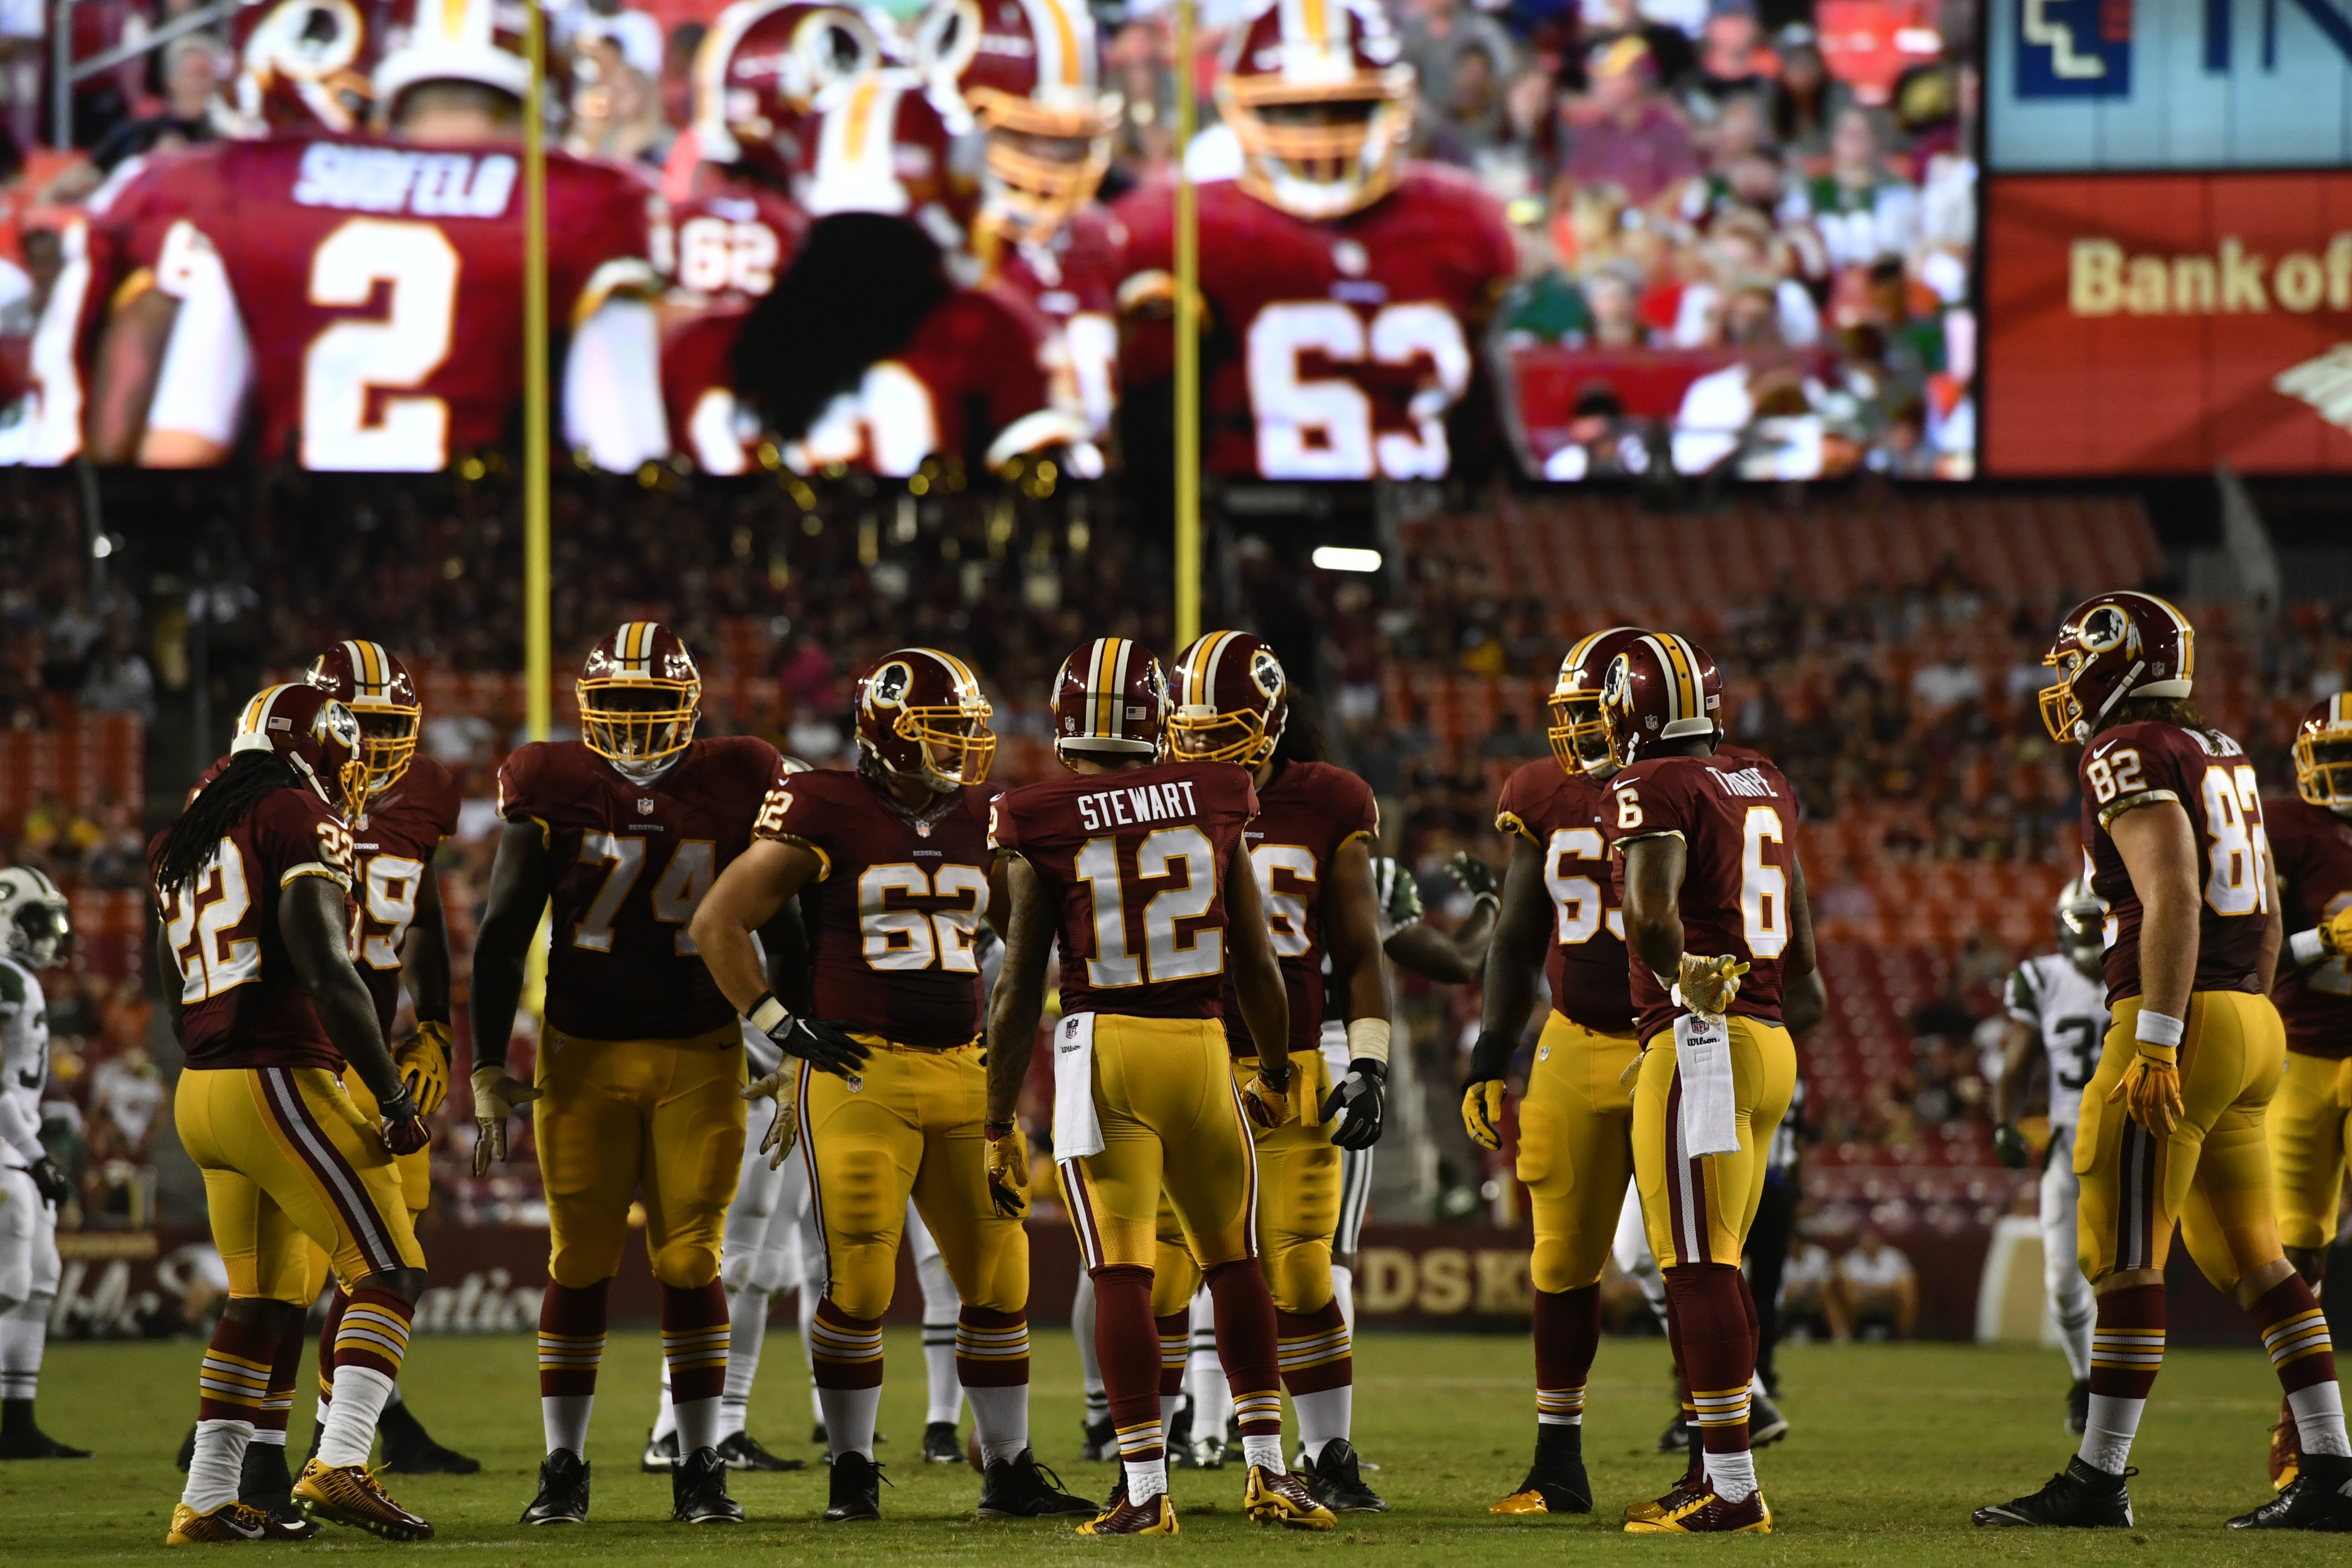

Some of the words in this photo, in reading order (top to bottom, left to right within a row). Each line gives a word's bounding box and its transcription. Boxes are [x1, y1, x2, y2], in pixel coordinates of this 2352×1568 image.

[680, 216, 779, 296] 62
[2069, 238, 2268, 316] Bank
[2274, 231, 2352, 311] of
[301, 217, 459, 472] 2
[1246, 302, 1471, 480] 63
[1077, 781, 1197, 830] STEWART
[1616, 788, 1643, 828] 6
[2087, 749, 2147, 804] 82
[156, 836, 262, 1004] 22
[349, 853, 425, 970] 9
[572, 828, 716, 956] 74
[858, 862, 990, 973] 62
[1074, 825, 1224, 988] 12
[1249, 844, 1317, 957] 6
[1544, 827, 1626, 945] 6
[1740, 806, 1787, 959] 6
[1061, 1045, 1081, 1053] Wilson
[1687, 1037, 1717, 1046] Wilson
